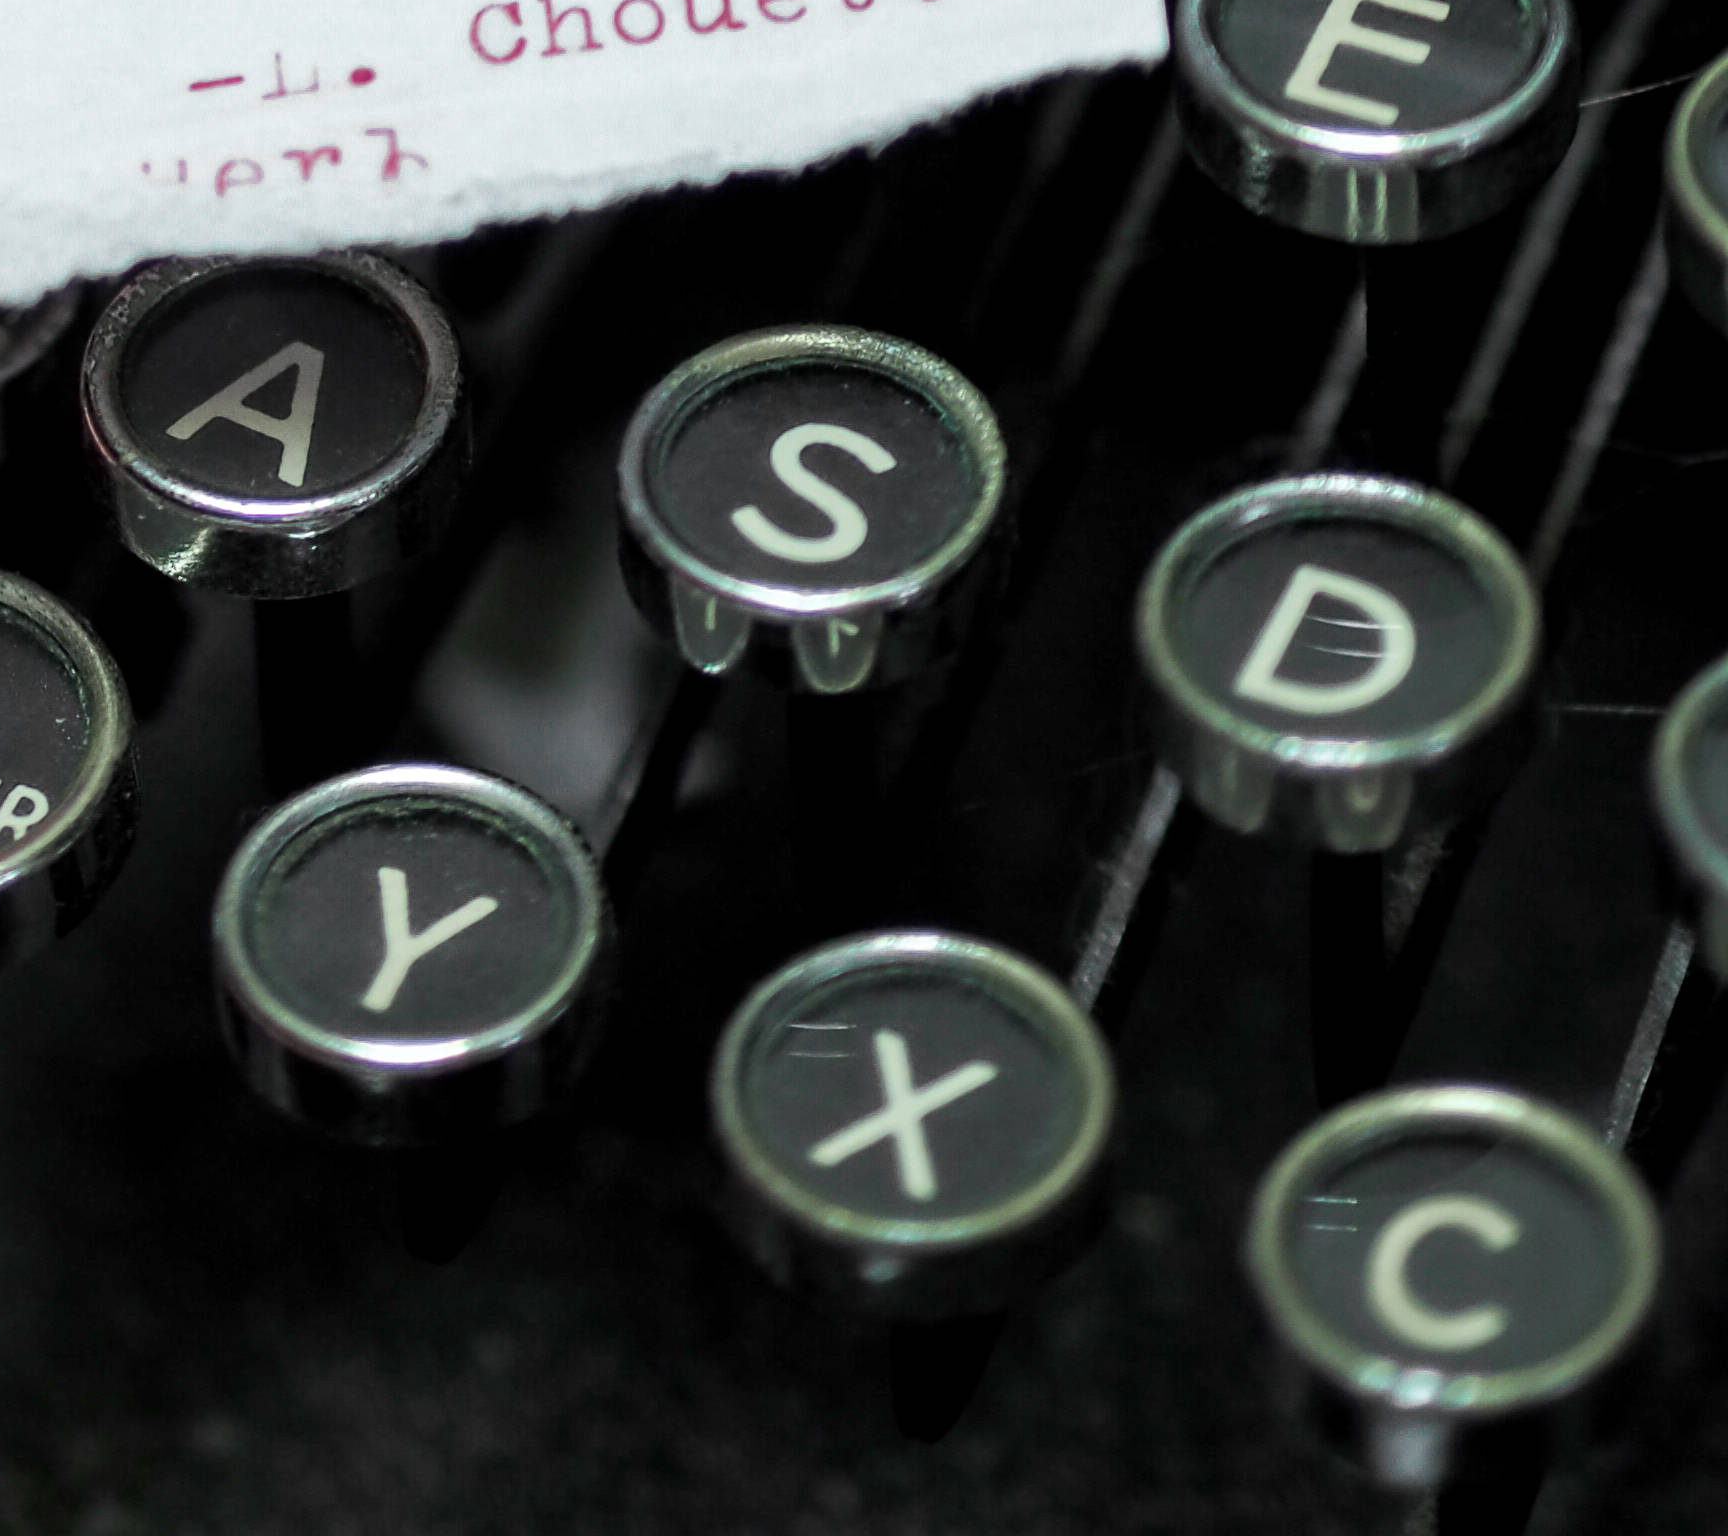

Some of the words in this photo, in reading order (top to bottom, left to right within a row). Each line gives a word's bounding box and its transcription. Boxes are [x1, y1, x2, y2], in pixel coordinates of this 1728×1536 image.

[164, 340, 327, 488] A
[730, 422, 897, 565] S
[1235, 565, 1416, 715] D
[361, 865, 499, 1012] Y
[810, 1030, 996, 1200] X
[1367, 1197, 1517, 1350] C
